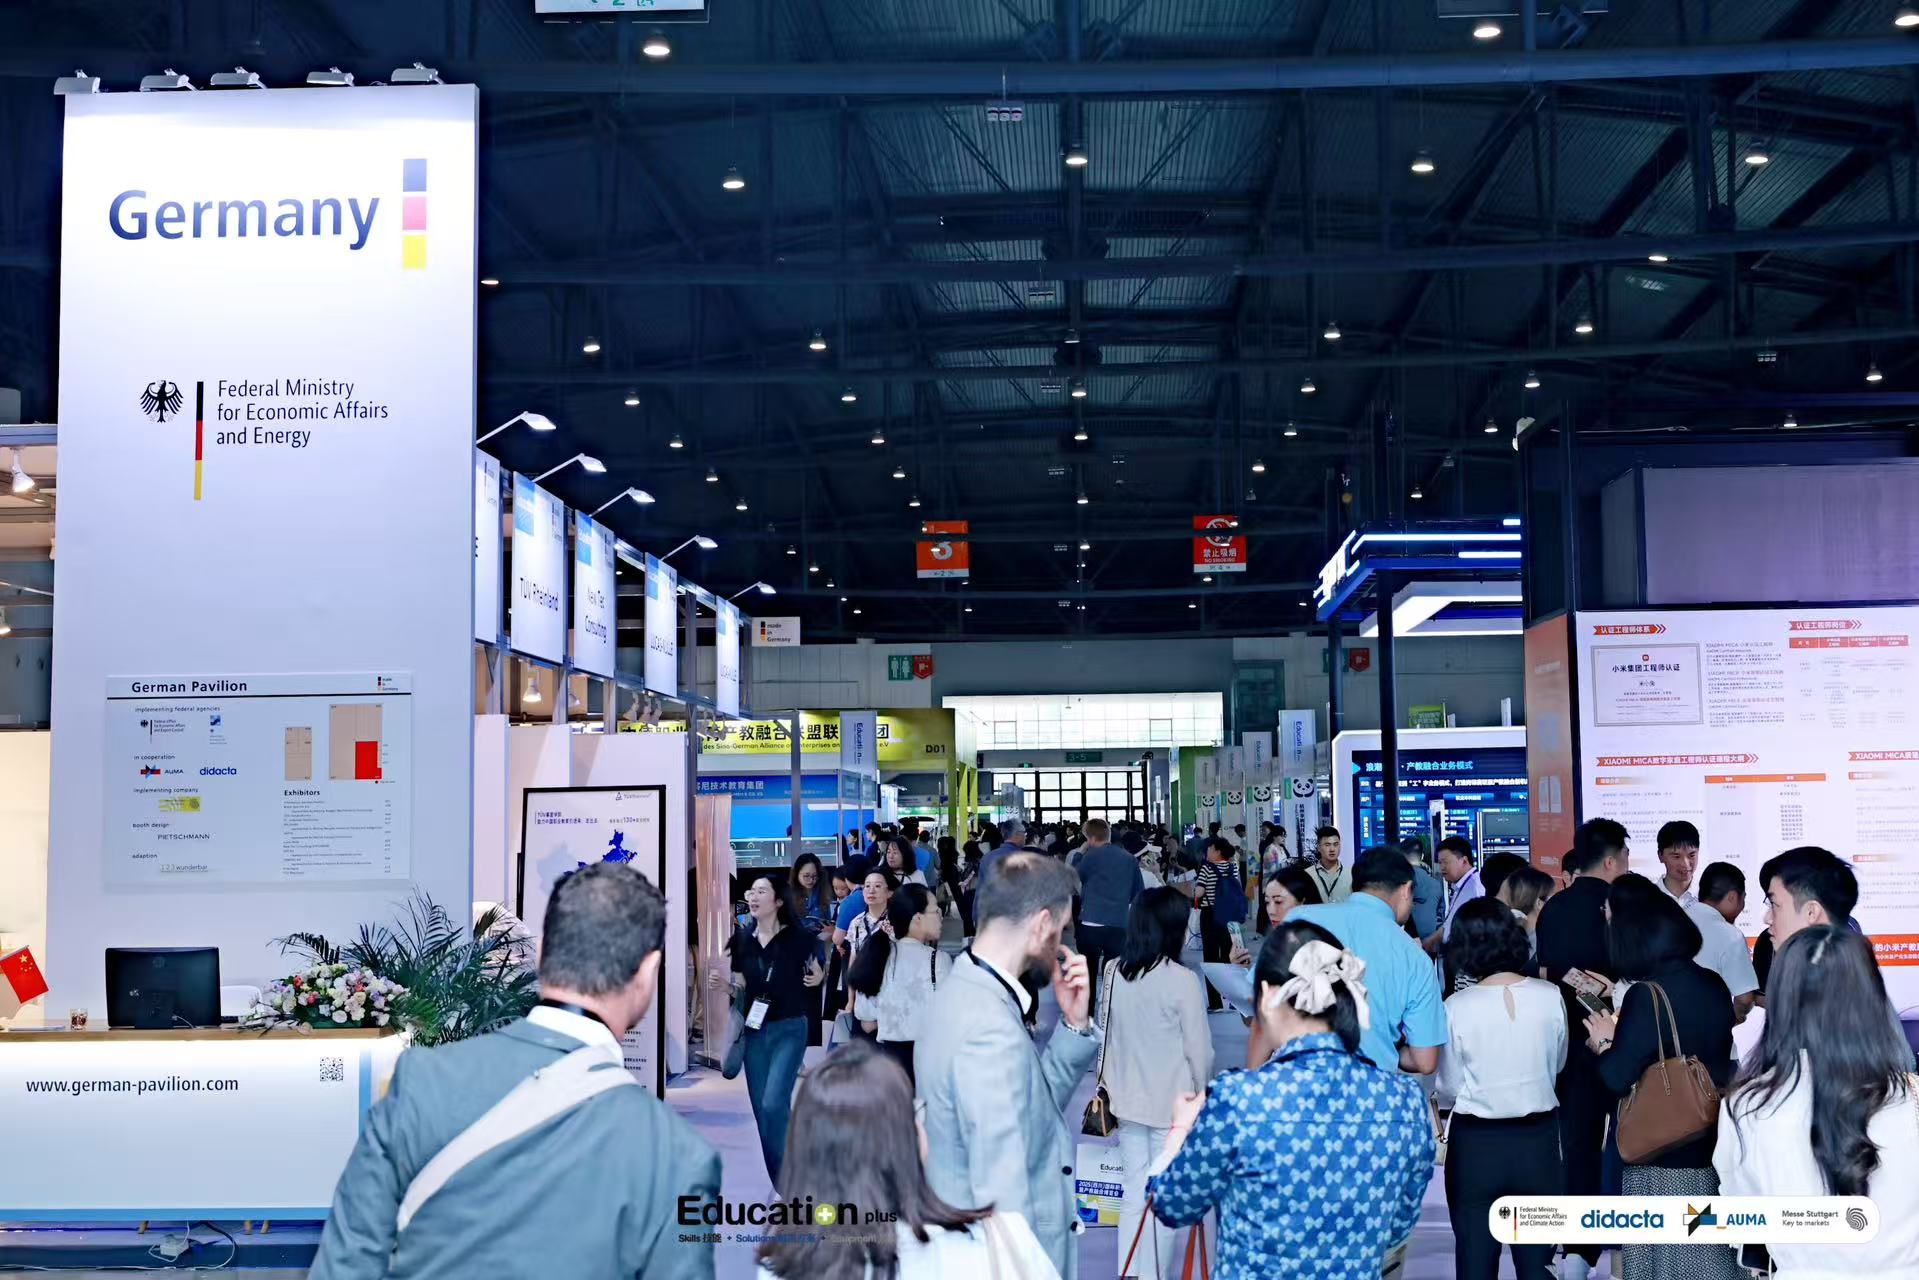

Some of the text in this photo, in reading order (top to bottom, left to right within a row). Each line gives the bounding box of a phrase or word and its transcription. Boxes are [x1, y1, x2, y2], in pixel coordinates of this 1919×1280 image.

[109, 190, 380, 250] Germany
[218, 379, 354, 399] Federal Ministry
[217, 400, 388, 420] for Economic Affairs
[216, 426, 311, 448] and Energy
[1203, 548, 1237, 557] 禁止吸烟
[1612, 664, 1680, 673] 小米集团工程师认证
[131, 680, 247, 693] German Pavilion
[174, 704, 195, 712] federal
[196, 705, 220, 713] agencies
[925, 744, 946, 754] D01
[1856, 752, 1882, 760] XIAOMI
[199, 766, 237, 775] didacta
[26, 1076, 239, 1095] www.german-pavilion.com
